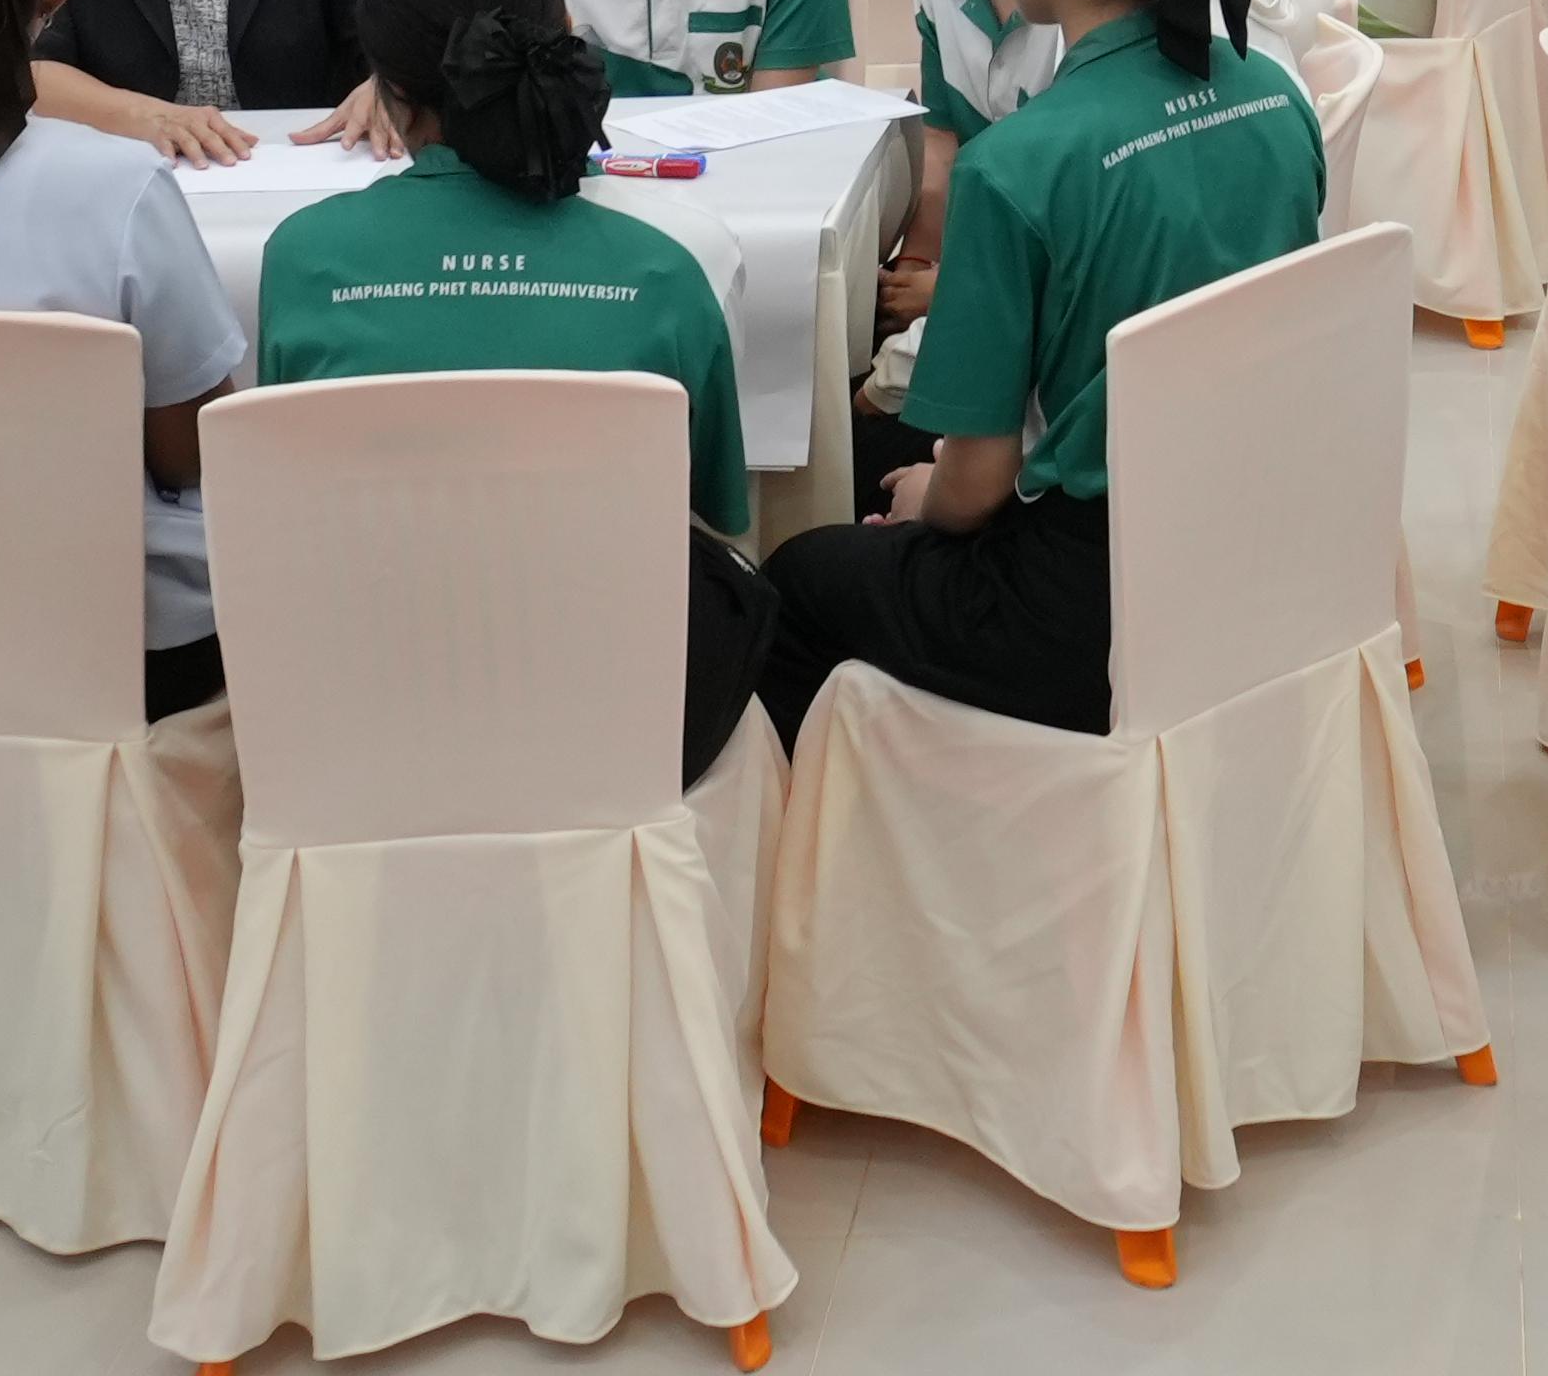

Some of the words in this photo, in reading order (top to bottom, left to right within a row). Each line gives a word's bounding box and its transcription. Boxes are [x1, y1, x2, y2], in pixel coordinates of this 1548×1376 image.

[1164, 87, 1218, 116] NURSE
[1102, 128, 1167, 170] KAMPHAENG
[1166, 118, 1193, 138] PHET
[442, 254, 526, 272] NURSE
[332, 282, 425, 304] KAMPHAENG
[428, 281, 468, 297] PHET
[470, 281, 639, 302] RAJABHATUNIVERSITY
